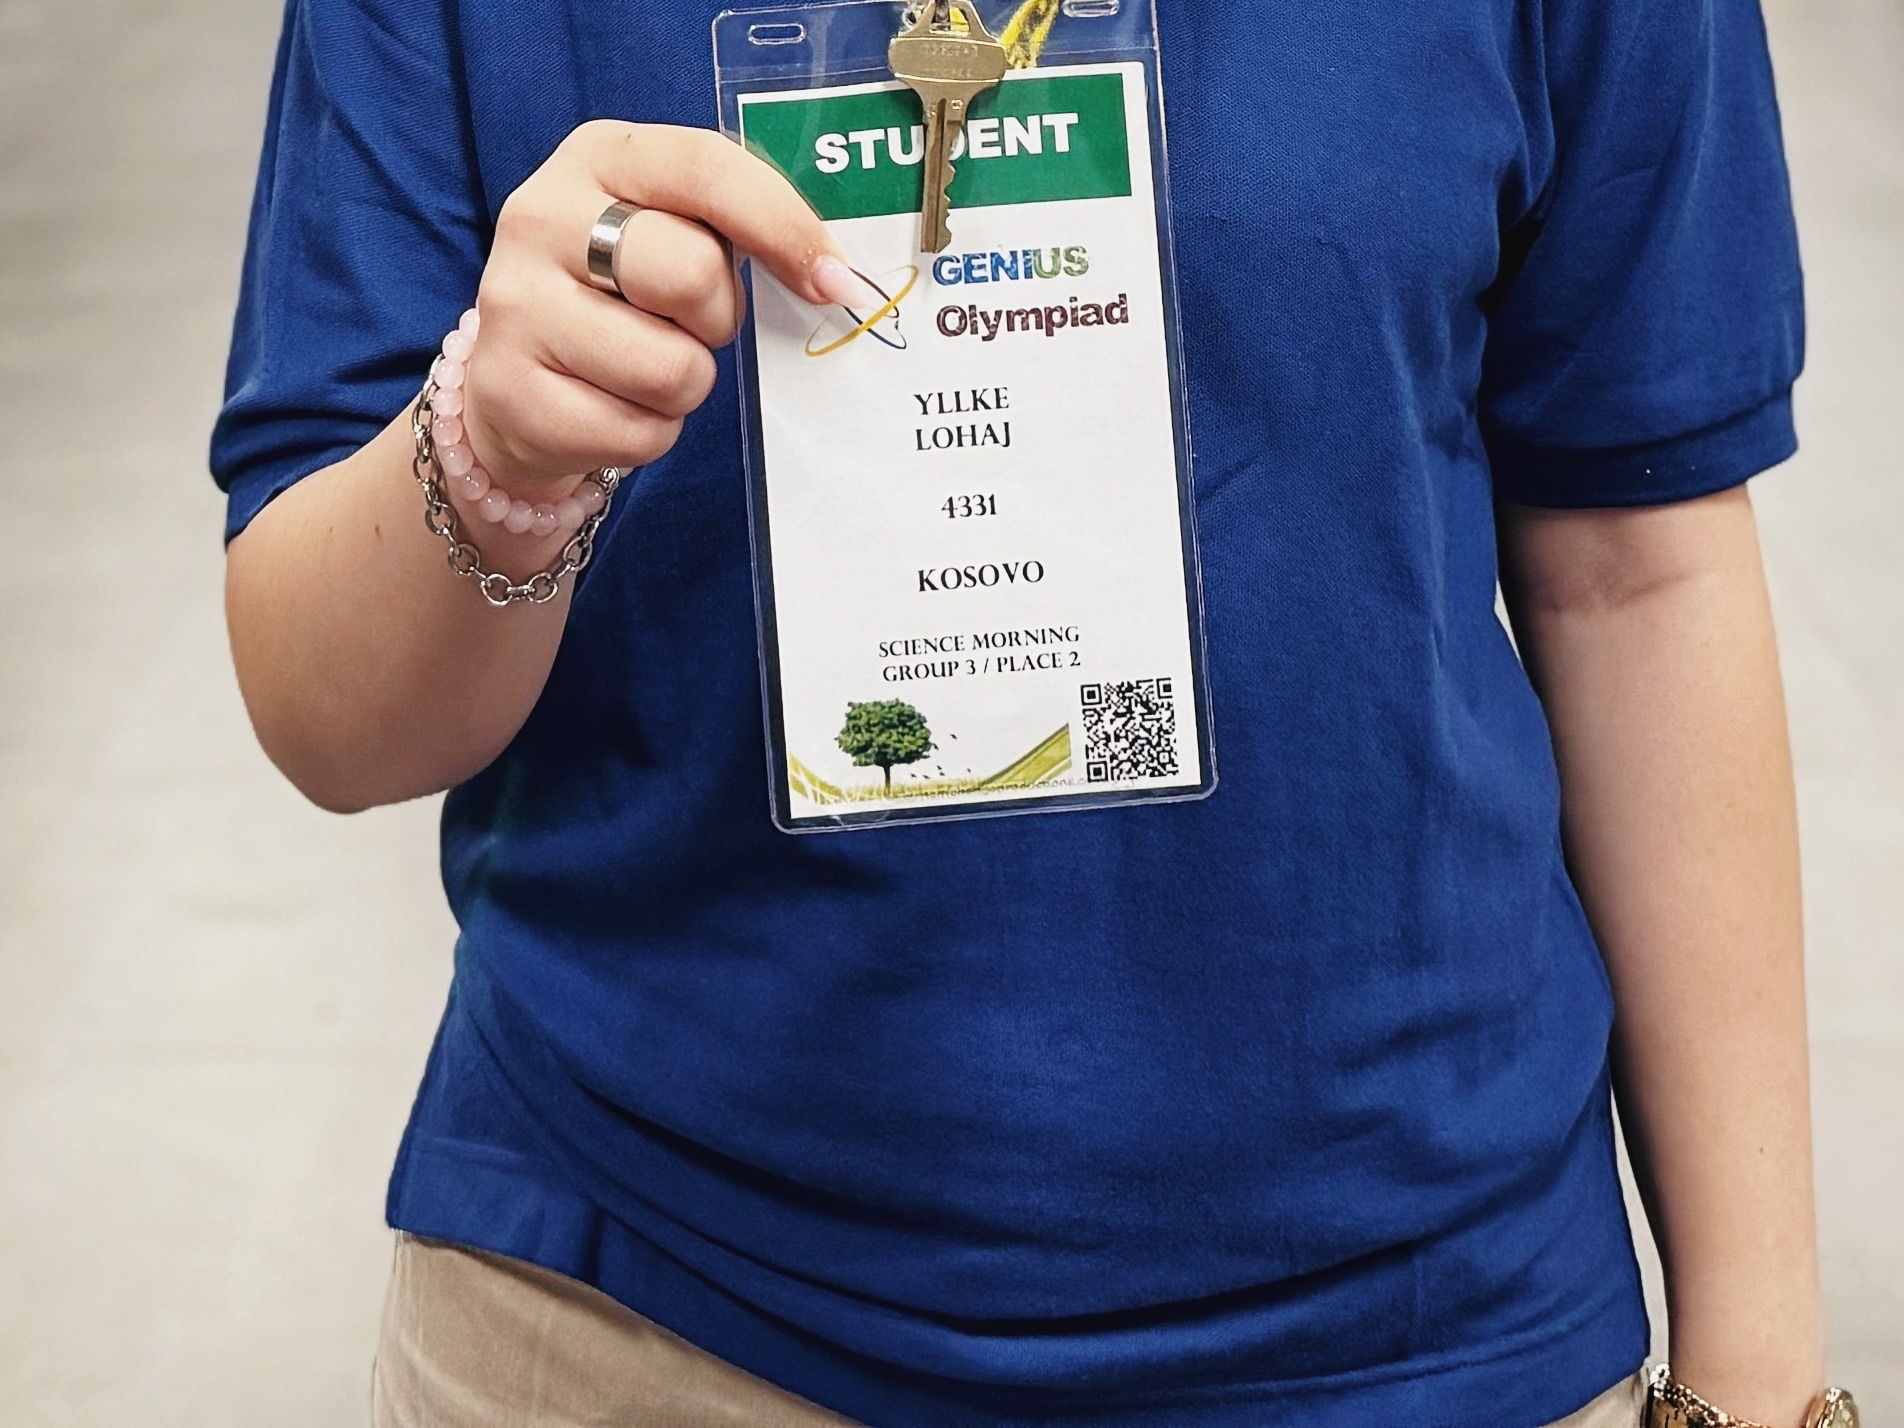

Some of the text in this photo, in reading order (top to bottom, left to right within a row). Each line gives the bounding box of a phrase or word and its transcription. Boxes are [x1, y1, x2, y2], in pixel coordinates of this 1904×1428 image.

[932, 245, 1090, 286] GENIUS
[936, 293, 1129, 342] Olympiad
[913, 386, 1010, 416] YLLKE
[915, 421, 1012, 451] LOHAJ
[940, 493, 998, 519] 4331
[917, 560, 1045, 593] KOSOVO
[878, 625, 1081, 658] SCIENCE MORNING
[882, 651, 1082, 682] GROUP 3 / PLACE 2
